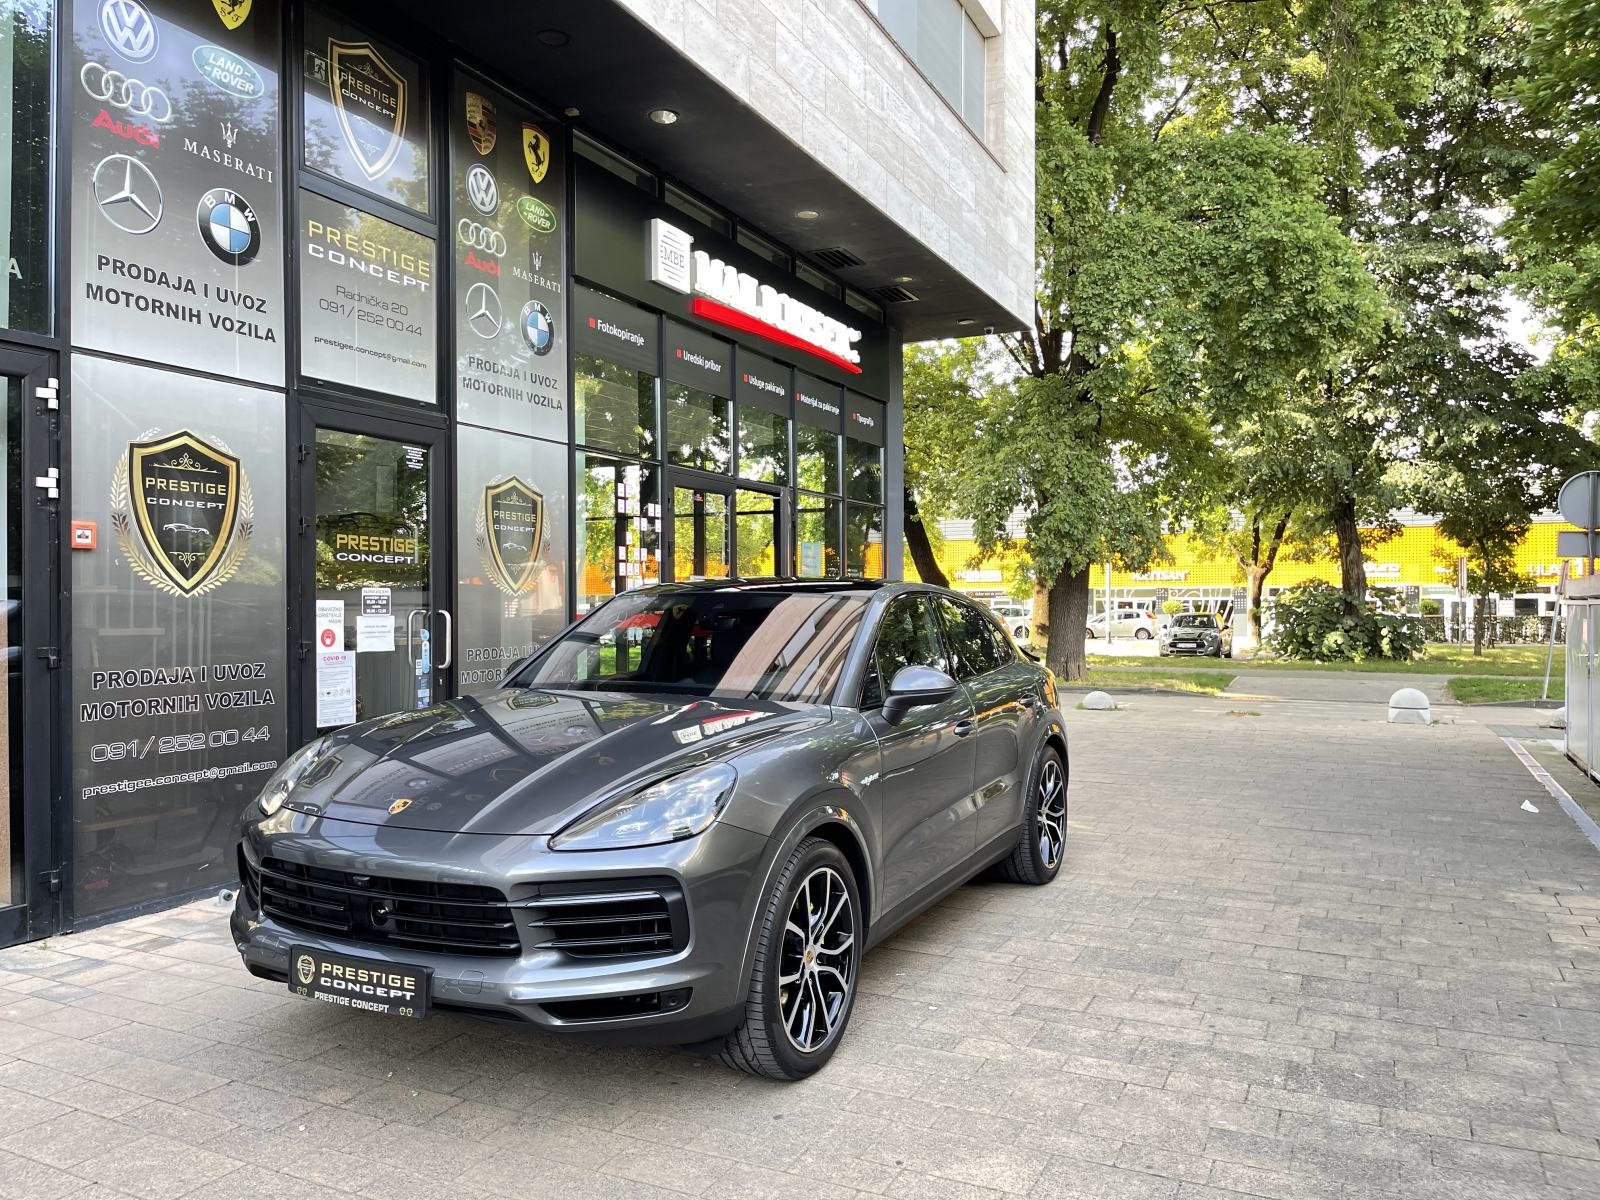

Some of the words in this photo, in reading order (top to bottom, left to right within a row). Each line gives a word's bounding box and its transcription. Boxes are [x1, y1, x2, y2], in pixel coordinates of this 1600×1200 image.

[340, 72, 397, 107] PRESTIGE
[341, 88, 396, 119] CONCEPT
[183, 138, 273, 183] MASERATI
[308, 220, 430, 278] PRESTIGE
[308, 243, 430, 292] CONCEPT
[512, 266, 561, 293] MASERATI
[97, 254, 197, 296] PRODAJA
[203, 283, 209, 298] I
[216, 287, 267, 314] UVOZ
[86, 282, 202, 325] MOTORNIH
[209, 312, 277, 343] VOZILA
[336, 285, 389, 311] Radnička
[391, 303, 409, 316] 20
[357, 309, 384, 326] 252
[406, 325, 423, 336] 44
[597, 320, 645, 346] Fotokopiranje
[314, 336, 427, 369] prestigee.concept@gmail.com
[683, 350, 705, 366] Uredski
[704, 360, 721, 372] pribor
[468, 356, 521, 381] PRODAJA
[523, 371, 527, 381] I
[530, 372, 558, 390] UVOZ
[462, 376, 523, 401] MOTORNIH
[526, 391, 563, 411] VOZILA
[146, 477, 227, 496] PRESTIGE
[146, 497, 225, 510] CONCEPT
[493, 510, 537, 523] PRESTIGE
[494, 524, 536, 533] CONCEPT
[336, 533, 415, 553] PRESTIGE
[336, 552, 414, 565] CONCEPT
[467, 646, 520, 662] PRODAJA
[91, 666, 196, 691] PRODAJA
[200, 665, 206, 683] I
[213, 662, 266, 681] UVOZ
[460, 668, 508, 685] MOTOR
[80, 694, 200, 722] MOTORNIH
[205, 688, 275, 711] VOZILA
[158, 730, 205, 756] 252
[208, 727, 239, 748] 00
[241, 724, 270, 744] 44
[82, 759, 278, 799] prestigee.concept@gmail.com
[320, 977, 415, 1000] CONCEPT
[321, 962, 415, 989] PRESTIGE
[314, 991, 350, 1006] PRESTIGE
[351, 998, 389, 1014] CONCEPT
